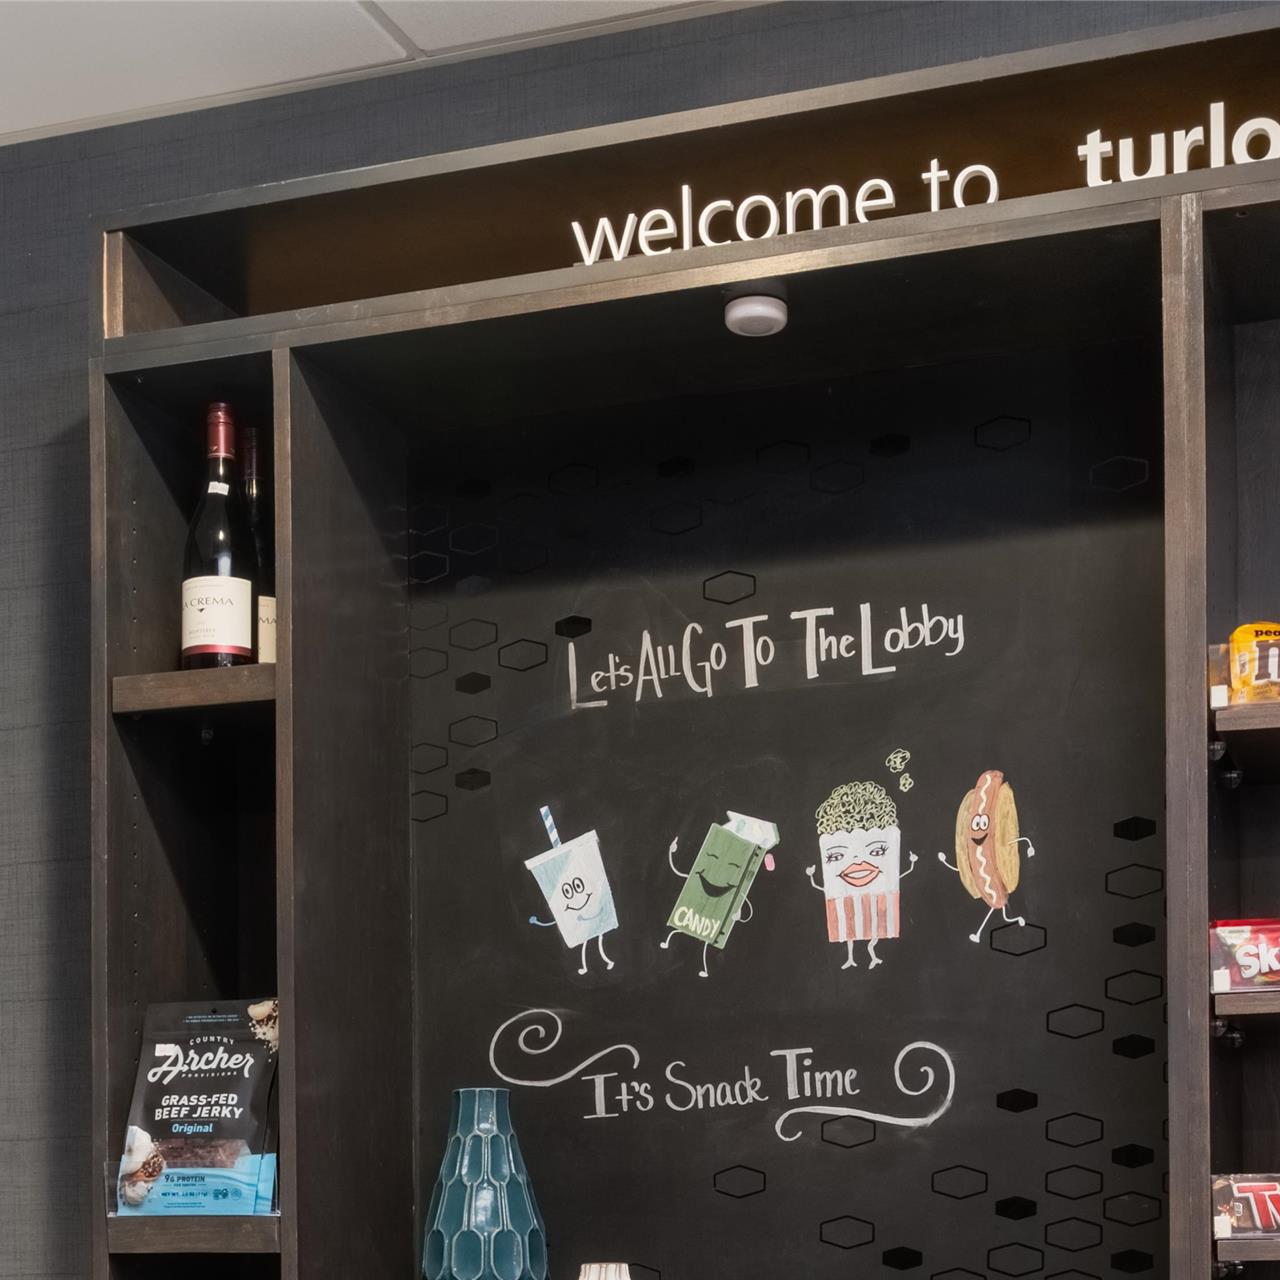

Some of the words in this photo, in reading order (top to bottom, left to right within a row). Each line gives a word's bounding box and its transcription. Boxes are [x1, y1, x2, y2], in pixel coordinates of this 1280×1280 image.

[571, 178, 895, 267] welcome
[921, 158, 998, 212] to
[568, 641, 634, 709] Let's
[725, 614, 775, 688] To
[790, 606, 856, 679] The
[859, 602, 965, 675] Lobby
[673, 905, 722, 940] CANDY
[189, 1035, 235, 1046] COUNTRY
[147, 1042, 255, 1086] Archer
[581, 1071, 655, 1119] It's
[665, 1060, 769, 1111] Snack
[770, 1047, 861, 1100] Time
[161, 1093, 239, 1107] GRASS-FED
[154, 1106, 190, 1121] BEEF
[191, 1105, 245, 1120] JERKY
[171, 1122, 214, 1135] Original
[175, 1174, 206, 1184] PROTEIN
